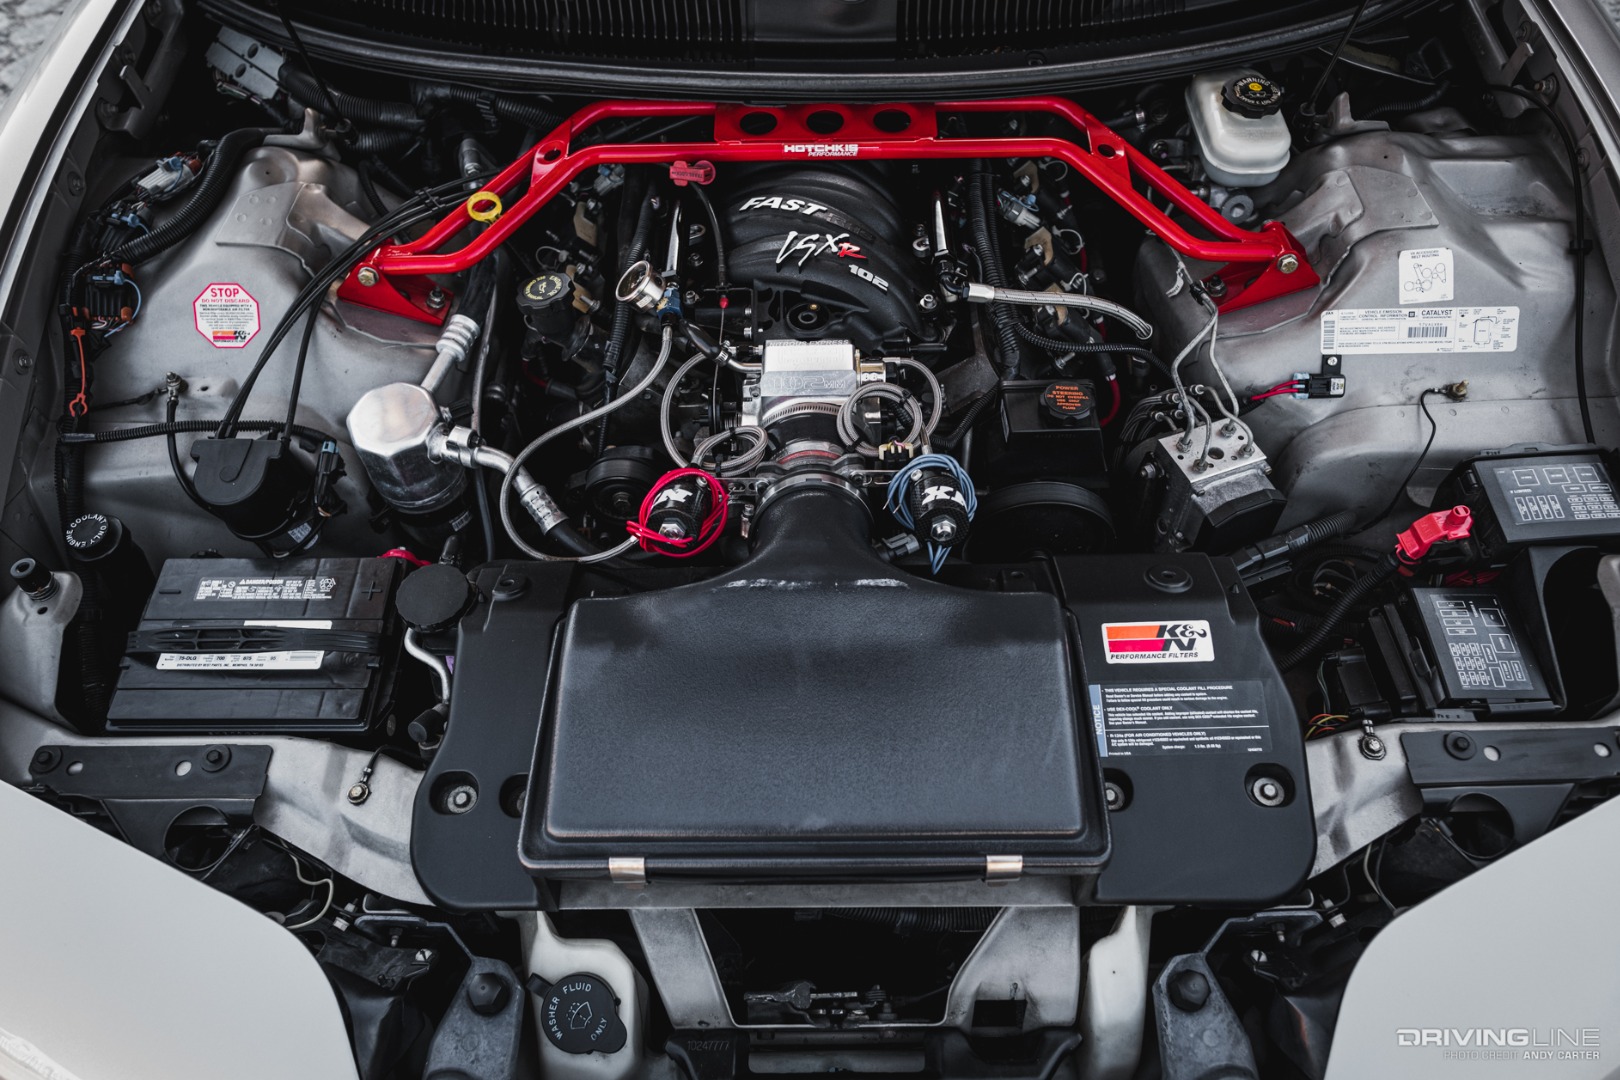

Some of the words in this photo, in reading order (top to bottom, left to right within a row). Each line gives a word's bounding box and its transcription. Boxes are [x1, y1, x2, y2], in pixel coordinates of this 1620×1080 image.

[1236, 78, 1270, 86] WARNING
[784, 144, 859, 153] HOTCHKIS
[738, 196, 828, 215] FAST
[848, 264, 890, 292] 102
[210, 288, 239, 297] STOP
[70, 514, 107, 528] COOLANT
[66, 529, 86, 548] ENGINE
[90, 525, 107, 544] ONLY
[1156, 624, 1207, 652] K&N
[1093, 704, 1102, 735] NOTICE
[562, 982, 592, 994] FLUID
[548, 996, 563, 1040] WASHER
[590, 1018, 607, 1040] ONLY
